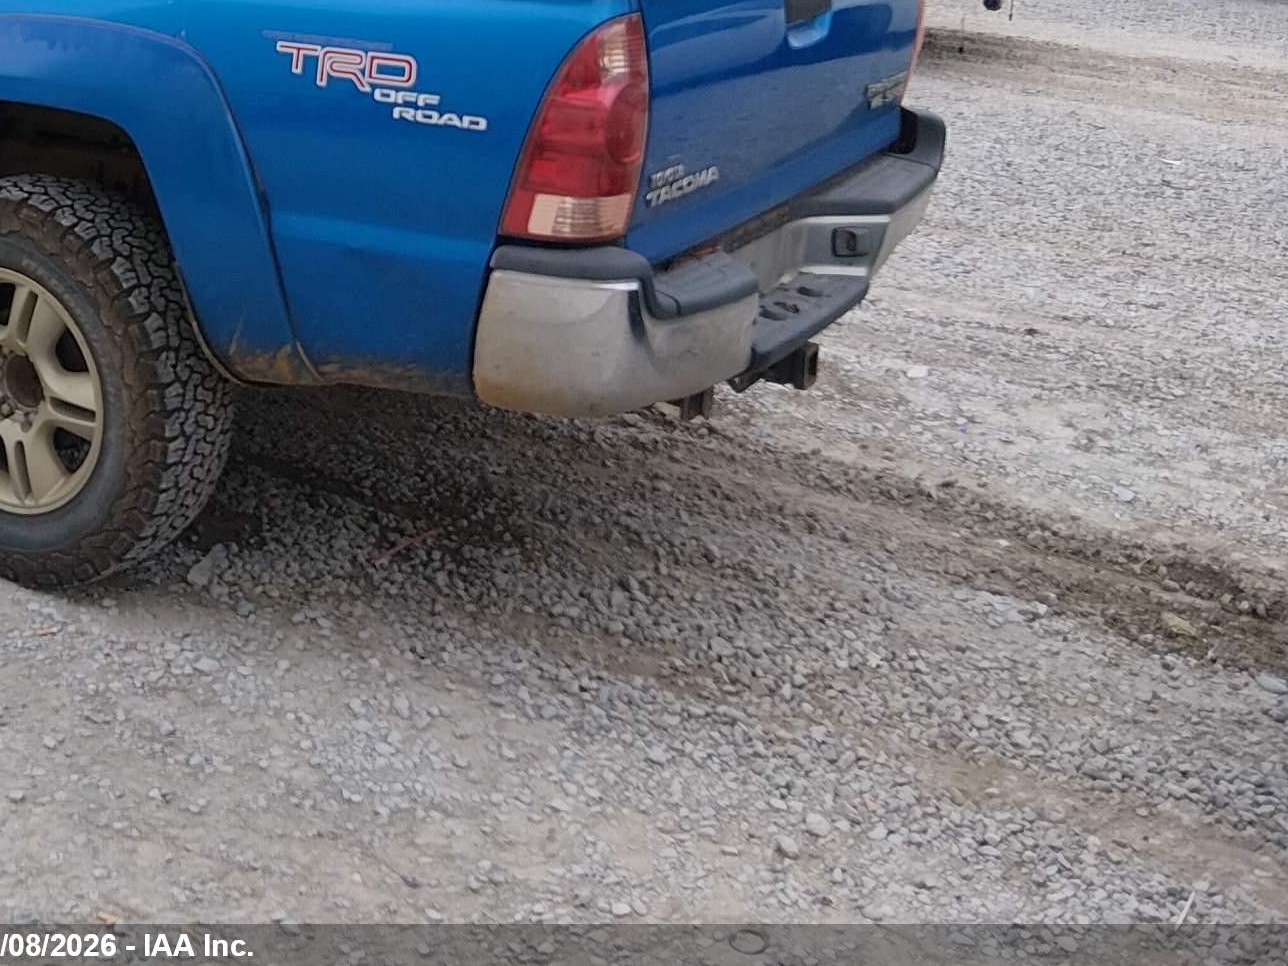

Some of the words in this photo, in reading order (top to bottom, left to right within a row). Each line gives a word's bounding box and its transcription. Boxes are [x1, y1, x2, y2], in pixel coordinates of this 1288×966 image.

[275, 40, 418, 93] TRD
[372, 87, 441, 107] OFF
[392, 105, 488, 131] ROAD
[645, 165, 720, 208] TACOMA
